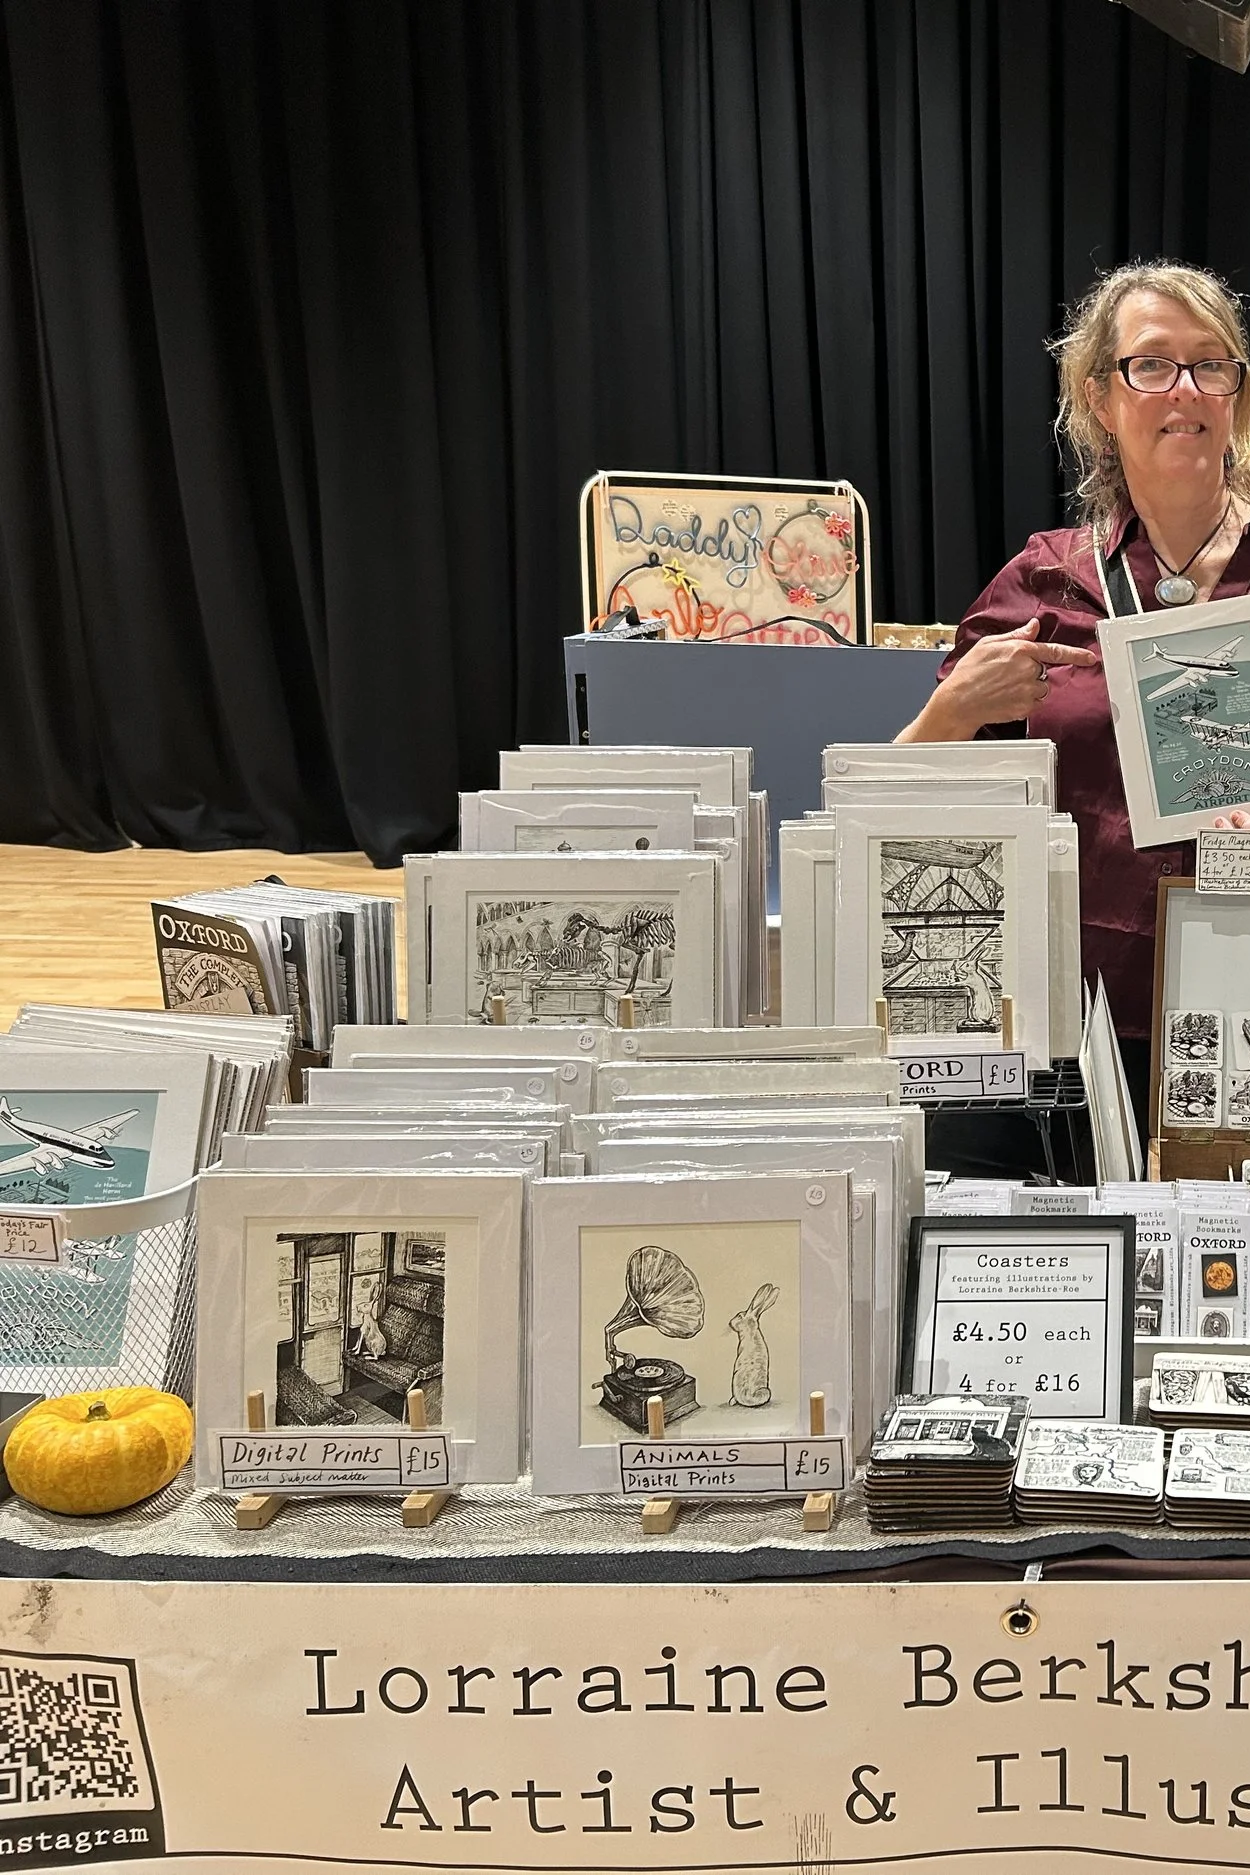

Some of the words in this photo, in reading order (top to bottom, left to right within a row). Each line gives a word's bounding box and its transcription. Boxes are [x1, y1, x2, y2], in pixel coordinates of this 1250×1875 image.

[1194, 794, 1250, 809] AIRPORT
[1203, 835, 1226, 848] Fridge
[1202, 867, 1210, 876] 4
[1212, 866, 1223, 877] for
[159, 914, 248, 953] OXFORD
[180, 963, 199, 988] THE
[200, 958, 246, 988] COMPLET
[988, 1064, 1017, 1086] £15
[903, 1085, 936, 1095] Prints
[1033, 1196, 1075, 1205] Magnetic
[29, 1221, 48, 1229] Fair
[1198, 1216, 1239, 1225] Magnetic
[1136, 1232, 1172, 1242] FORD
[1196, 1226, 1241, 1234] Bookmarks
[4, 1237, 47, 1254] £12
[1190, 1236, 1246, 1249] OXFORD
[977, 1254, 1070, 1268] Coasters
[952, 1274, 1000, 1284] featuring
[1006, 1274, 1077, 1283] illustrations
[1082, 1274, 1094, 1284] by
[958, 1286, 1003, 1294] Lorraine
[1008, 1285, 1080, 1294] Berkshire-Roe
[952, 1322, 1028, 1342] £4.50
[1044, 1326, 1092, 1342] each
[1004, 1355, 1024, 1364] or
[959, 1373, 972, 1392] 4
[986, 1379, 1018, 1392] for
[1034, 1374, 1080, 1392] £16
[232, 1441, 306, 1466] Digital
[322, 1442, 384, 1465] Prints
[406, 1447, 441, 1475] £15
[796, 1450, 830, 1475] £15
[231, 1470, 270, 1484] Mixed
[279, 1470, 324, 1486] Subject
[328, 1472, 370, 1483] matter
[628, 1470, 678, 1488] Digital
[688, 1469, 736, 1486] Prints
[304, 1646, 829, 1717] Lorraine
[380, 1763, 765, 1836] Artist
[845, 1764, 897, 1823] &
[0, 1827, 149, 1854] nstagram
